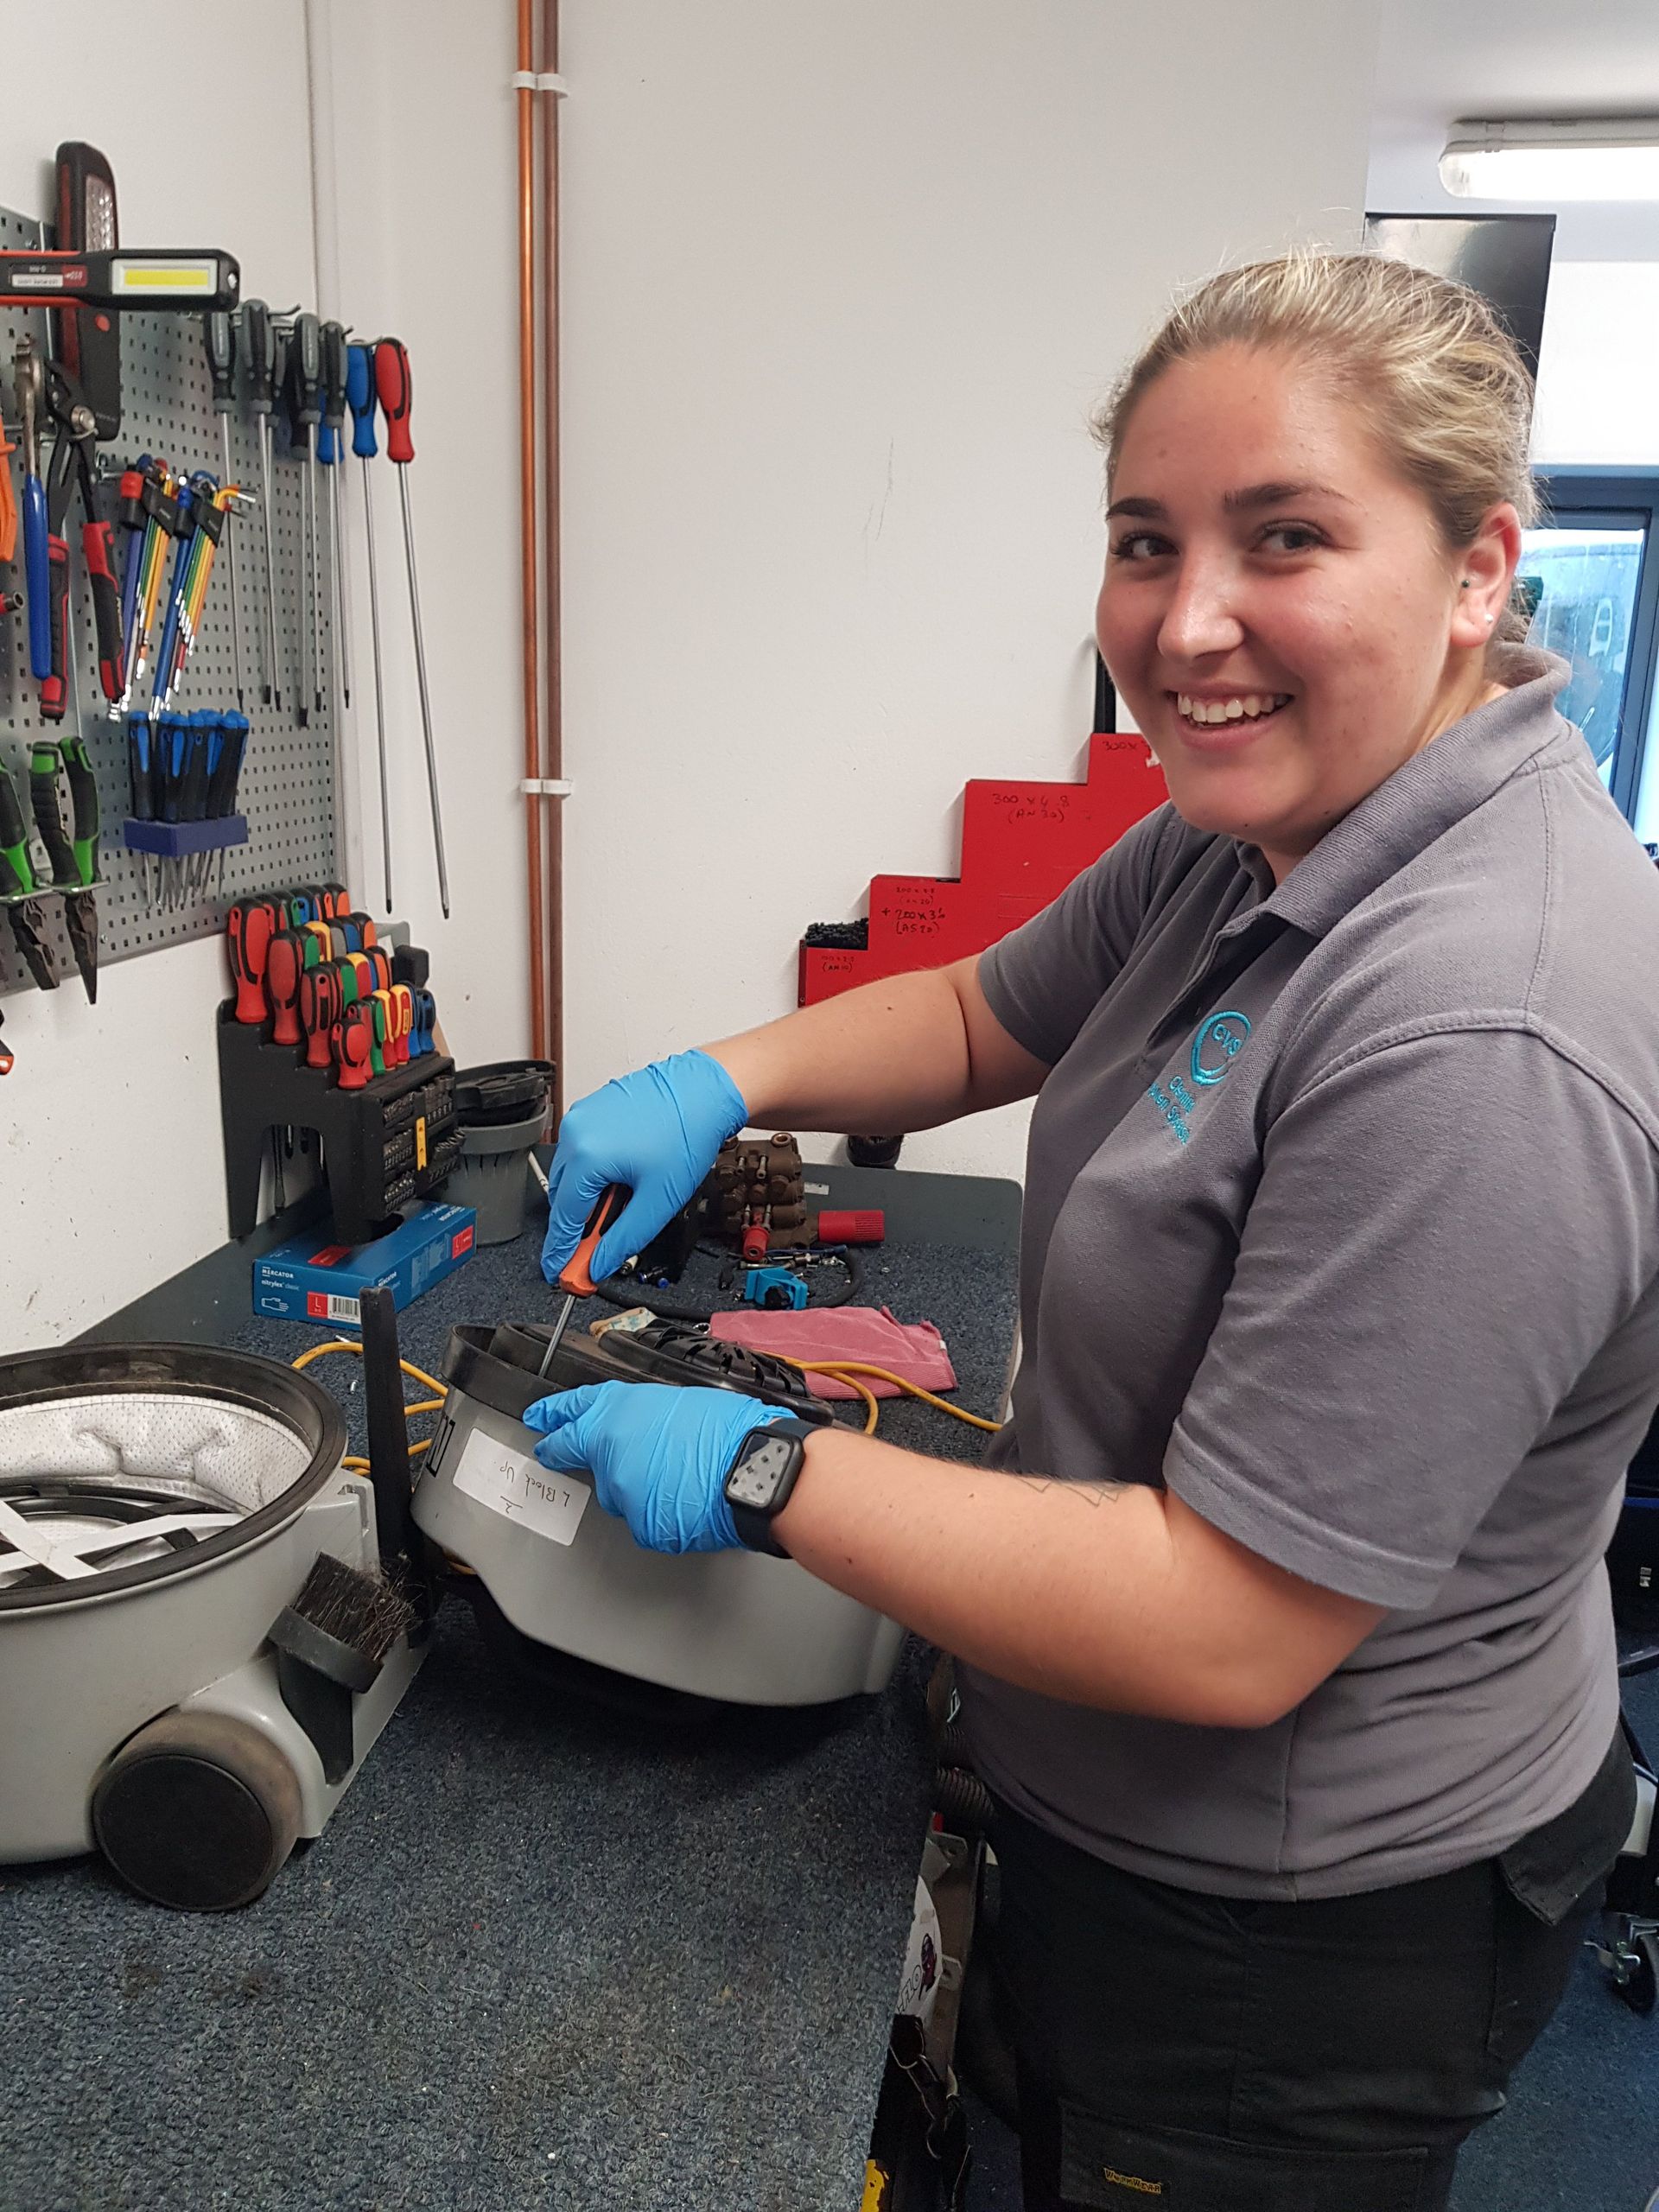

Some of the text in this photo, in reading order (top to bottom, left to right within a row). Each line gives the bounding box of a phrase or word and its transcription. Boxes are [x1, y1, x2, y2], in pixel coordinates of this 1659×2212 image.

[992, 793, 1020, 804] 300
[262, 1268, 295, 1279] MERCATOR
[315, 1297, 321, 1308] L
[524, 1473, 556, 1503] Block
